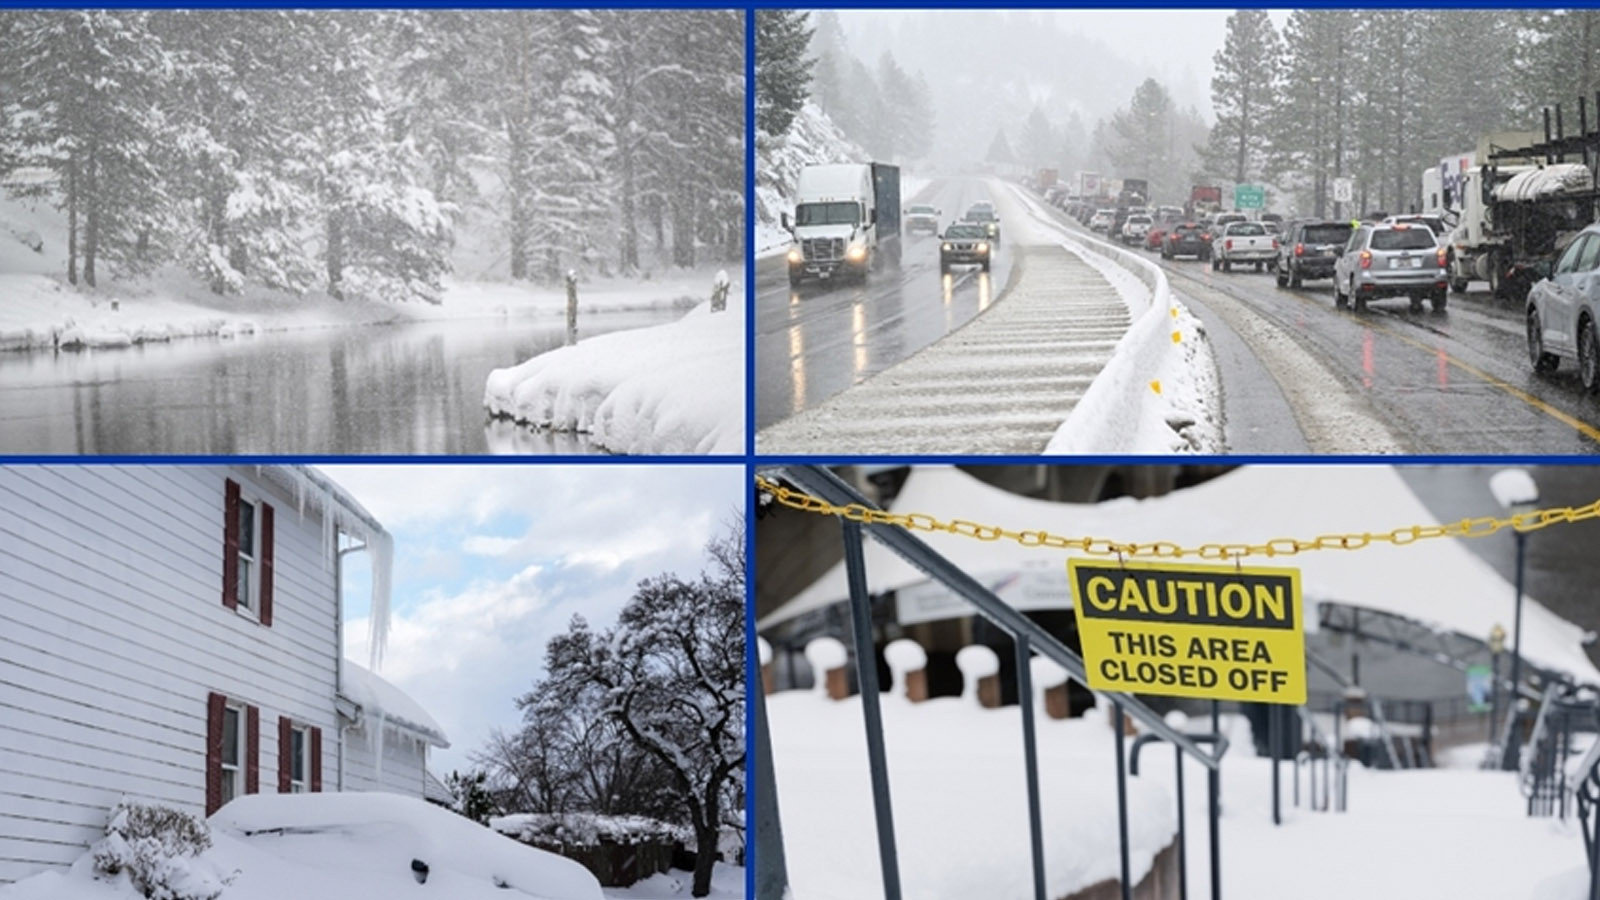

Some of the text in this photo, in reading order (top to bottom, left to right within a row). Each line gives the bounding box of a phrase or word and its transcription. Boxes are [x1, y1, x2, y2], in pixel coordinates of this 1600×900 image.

[1086, 575, 1285, 621] CAUTION
[1107, 631, 1272, 664] THIS AREA
[1100, 659, 1288, 693] CLOSED OFF
